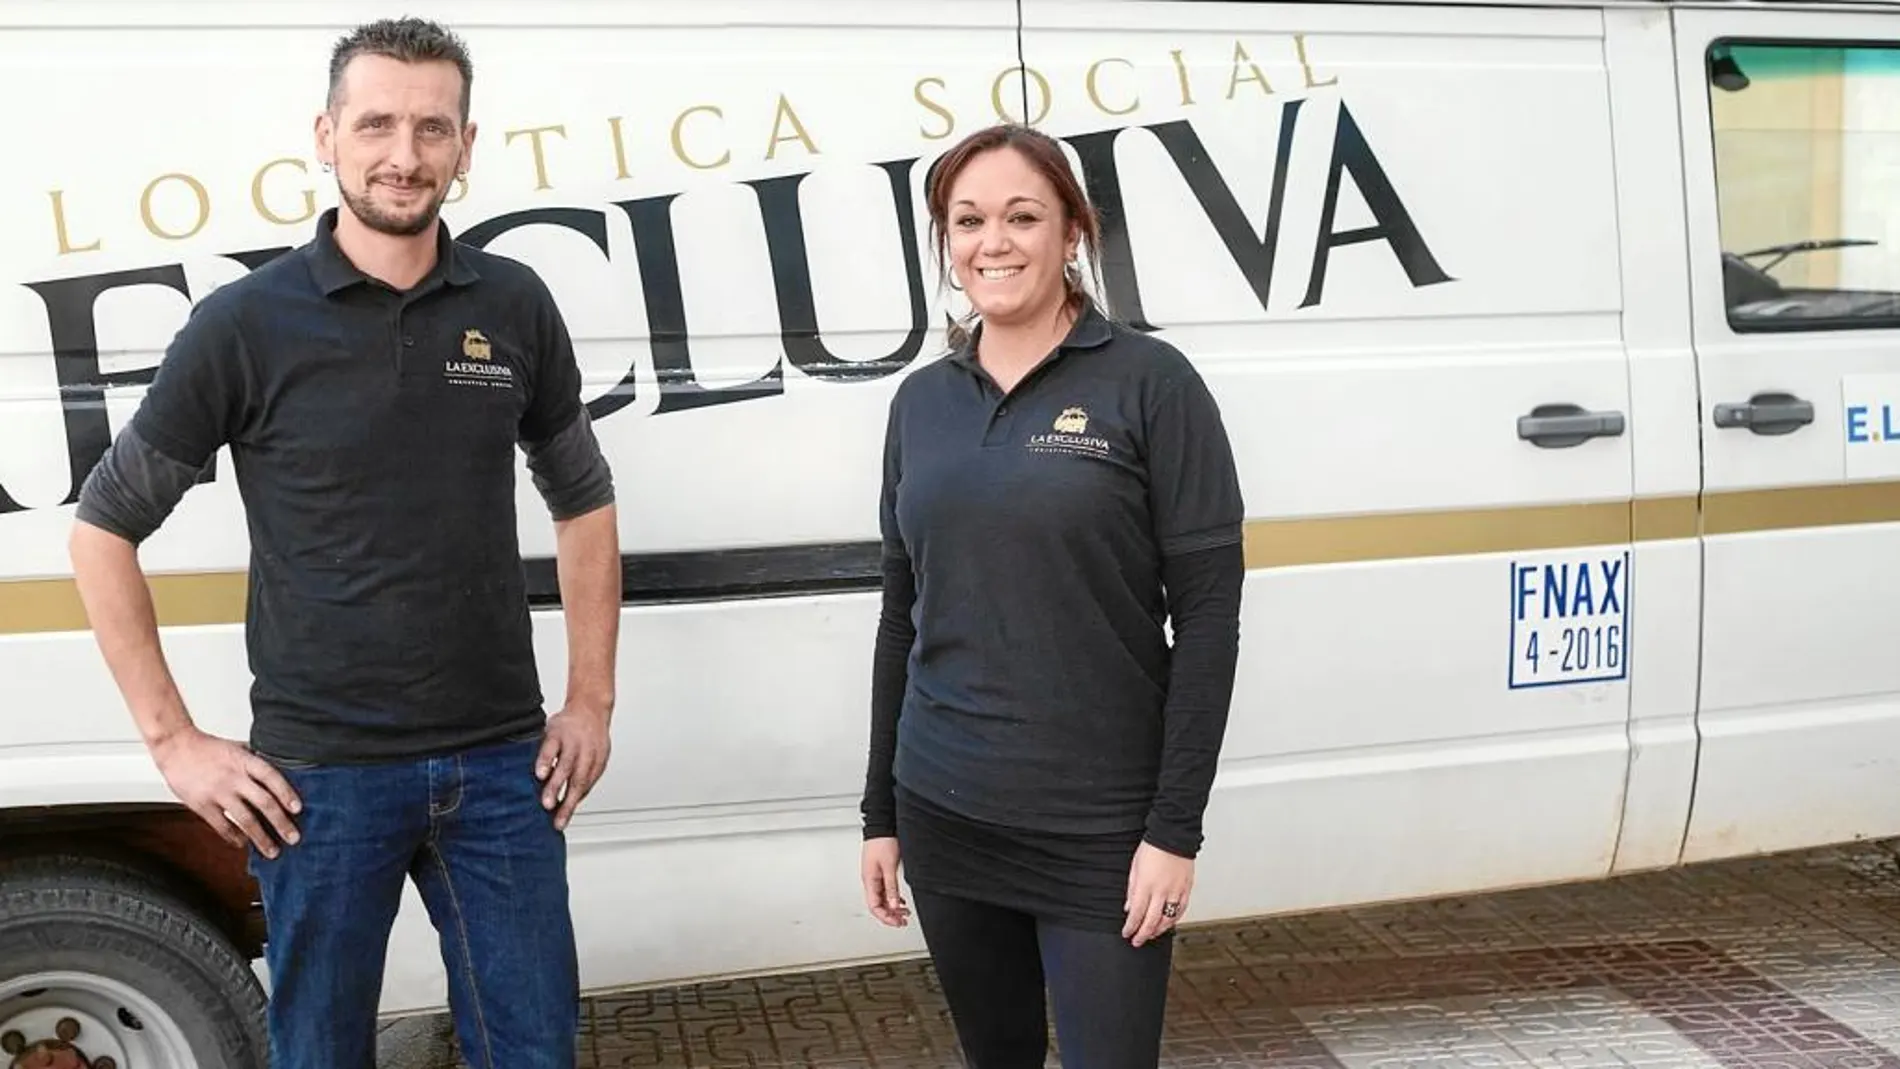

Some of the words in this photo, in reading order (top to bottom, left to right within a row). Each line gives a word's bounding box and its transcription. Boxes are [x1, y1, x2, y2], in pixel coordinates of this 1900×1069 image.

[50, 92, 821, 255] LOGTICA
[914, 34, 1338, 140] SOCIAL
[20, 97, 1458, 506] ECLUIVA
[1046, 434, 1109, 450] EXCLUSIVA
[1518, 560, 1621, 620] FNAX
